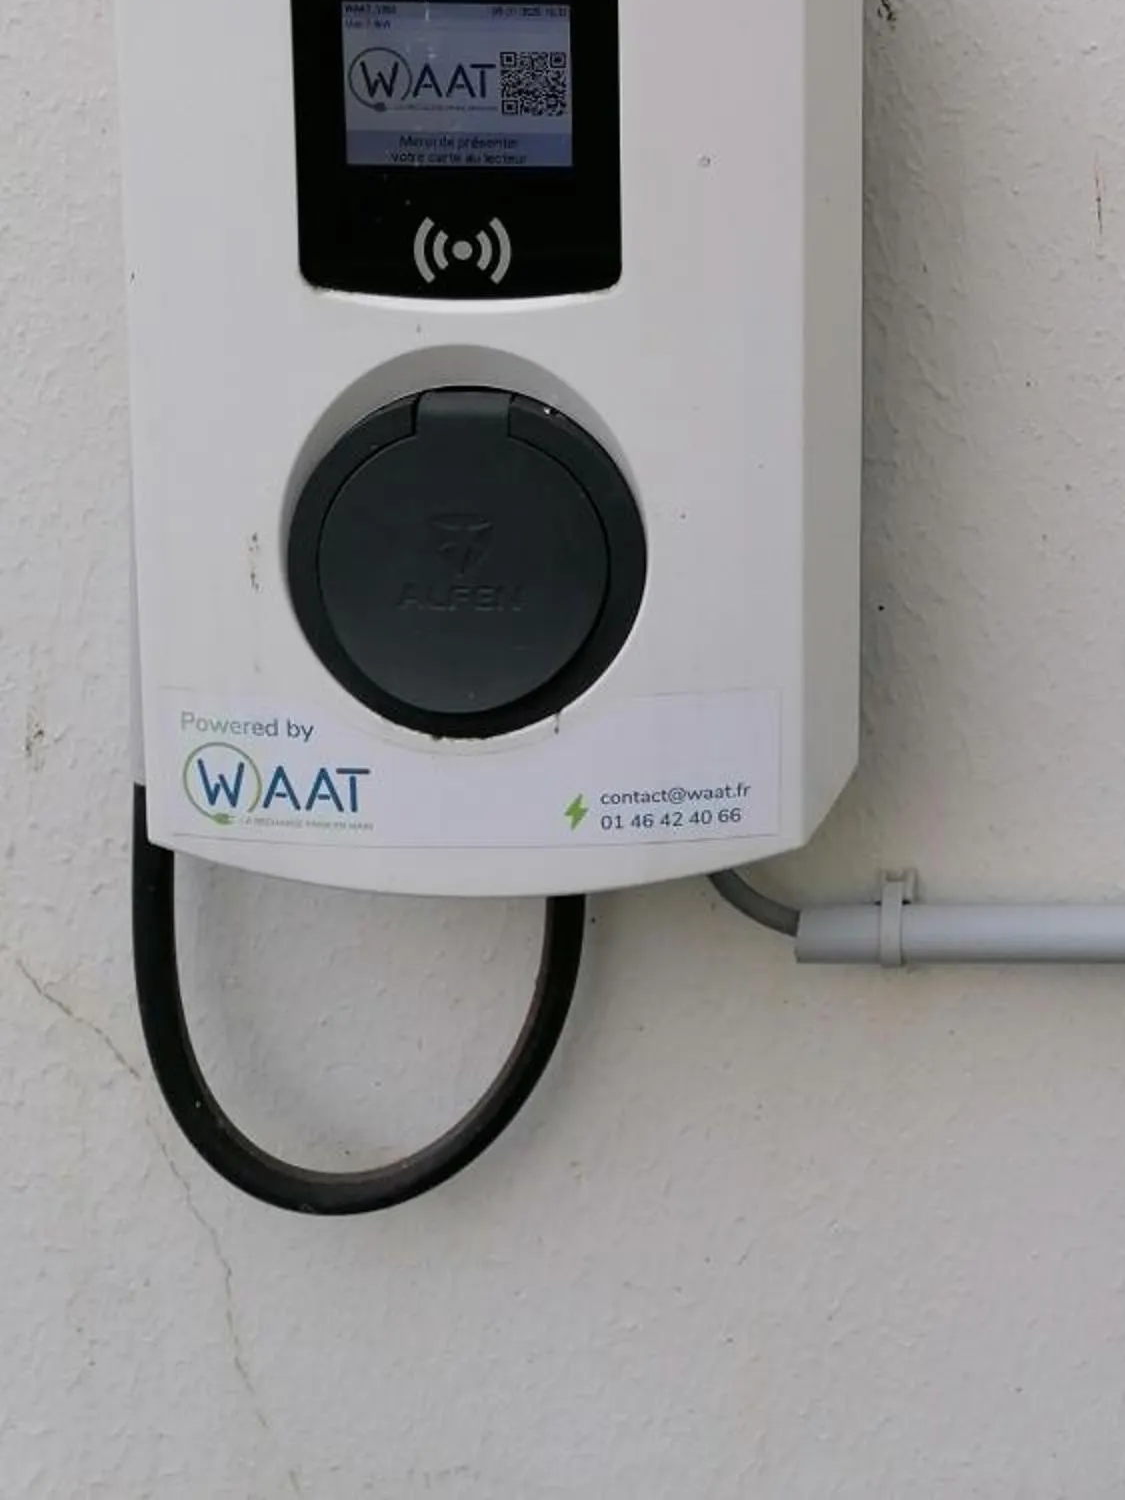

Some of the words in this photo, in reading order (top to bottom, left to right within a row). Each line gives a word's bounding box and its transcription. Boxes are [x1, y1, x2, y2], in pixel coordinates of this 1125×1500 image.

[360, 61, 497, 98] WAAT
[181, 711, 278, 736] Powered
[287, 720, 314, 742] by
[197, 758, 371, 813] WAAT
[601, 782, 751, 805] contact@waat.fr
[601, 815, 624, 830] 01
[631, 813, 654, 829] 46
[660, 812, 683, 827] 42
[689, 810, 712, 825] 40
[718, 808, 742, 823] 66
